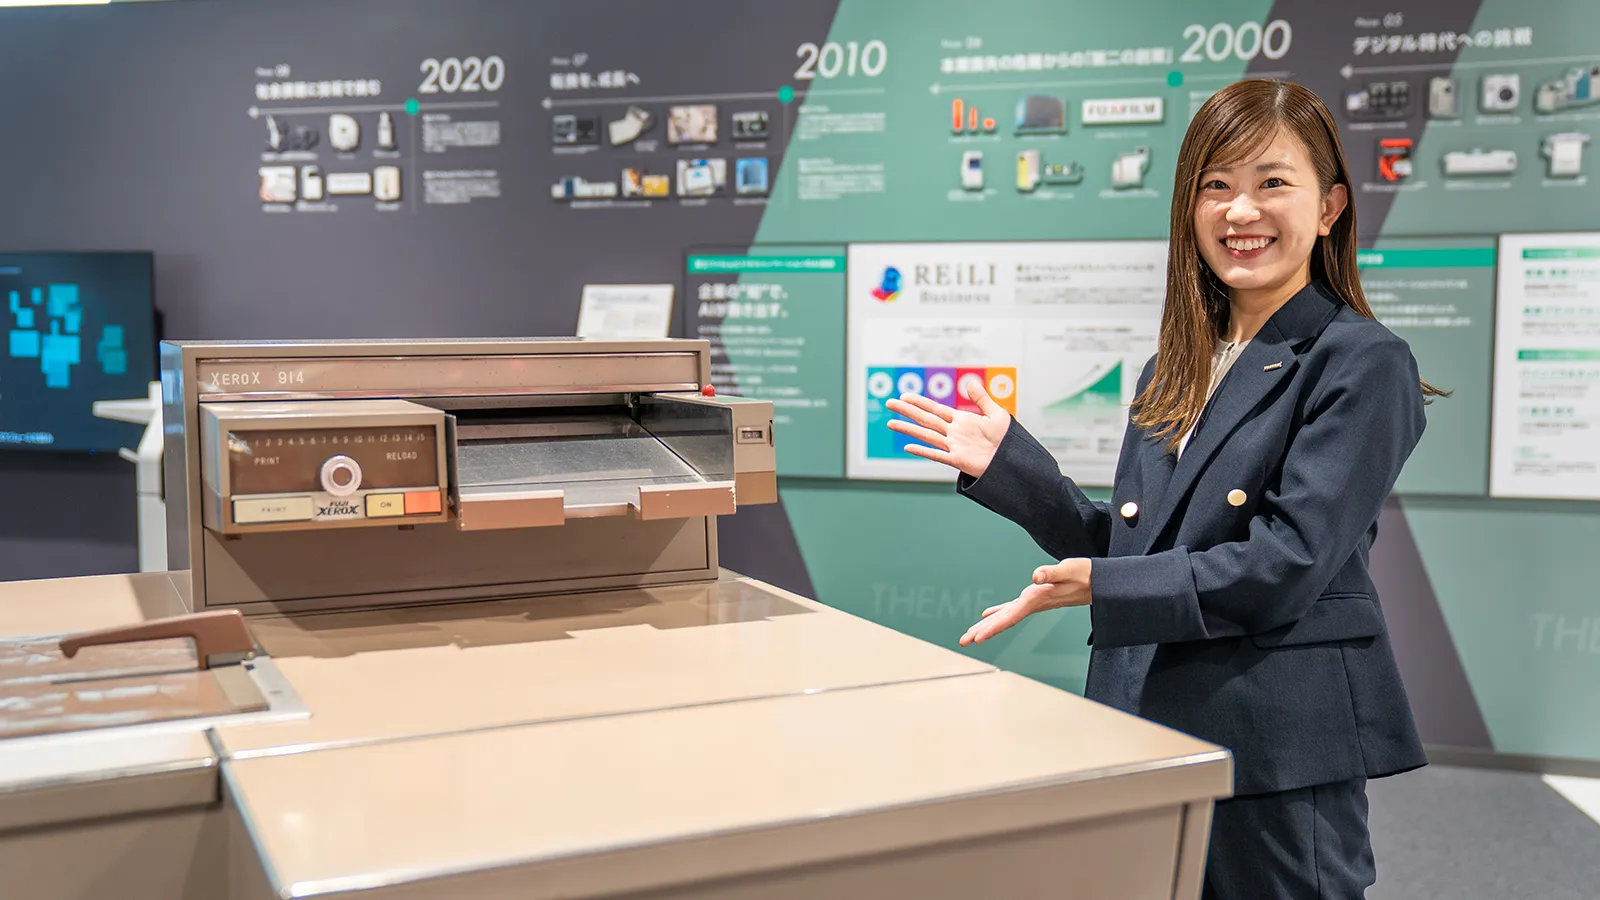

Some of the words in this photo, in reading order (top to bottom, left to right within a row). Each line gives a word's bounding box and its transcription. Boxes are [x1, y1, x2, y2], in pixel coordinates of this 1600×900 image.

[1179, 19, 1292, 64] 2000
[1352, 26, 1532, 55] デジタル時代への挑戦
[794, 40, 887, 80] 2010
[418, 55, 505, 93] 2020
[278, 371, 304, 384] 914
[354, 434, 363, 443] 10
[367, 434, 375, 442] 11
[380, 433, 388, 443] 12
[392, 433, 401, 442] 13
[404, 432, 413, 442] 14
[416, 432, 425, 441] 15
[254, 457, 280, 465] PRINT
[386, 451, 417, 461] RELOAD
[317, 505, 359, 516] XEROX
